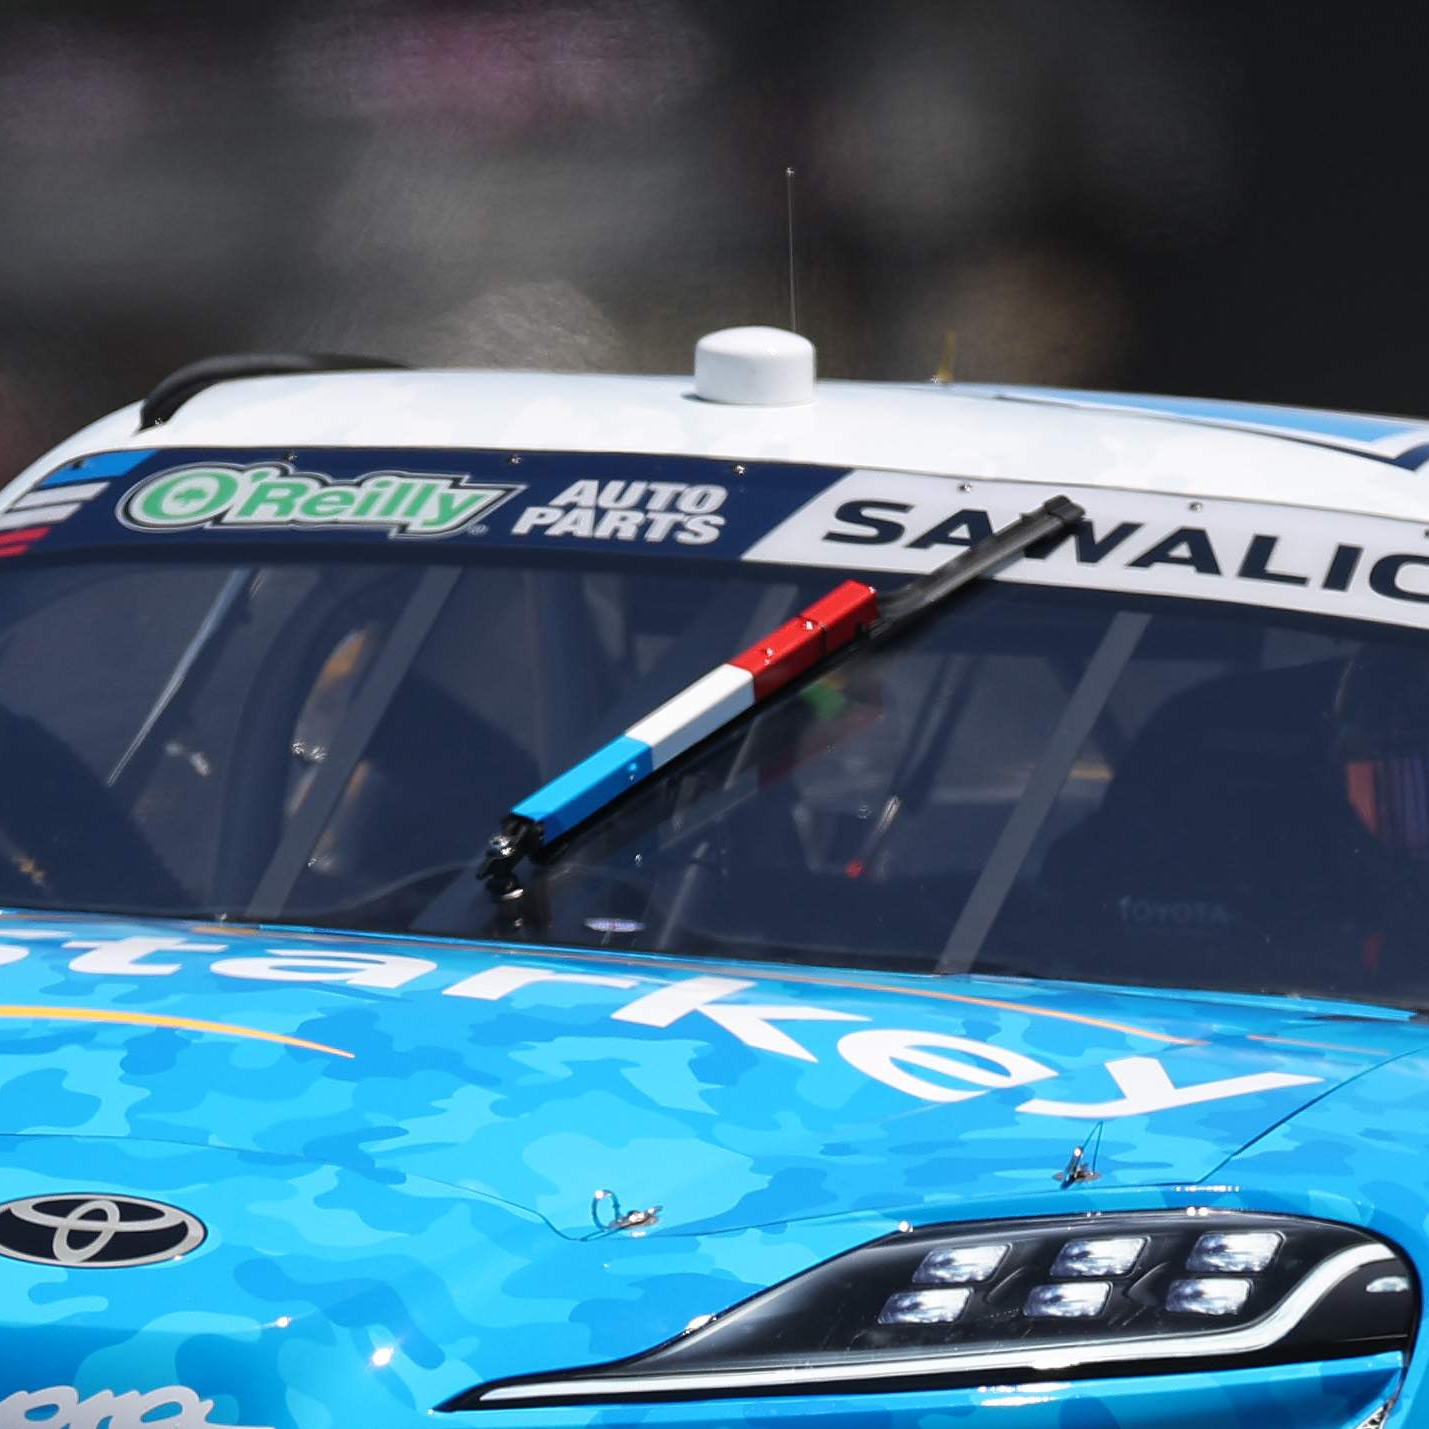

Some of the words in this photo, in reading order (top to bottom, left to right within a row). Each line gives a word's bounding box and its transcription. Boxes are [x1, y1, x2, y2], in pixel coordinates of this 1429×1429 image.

[137, 462, 495, 530] O'Reilly
[545, 478, 728, 513] AUTO
[511, 506, 727, 545] PARTS
